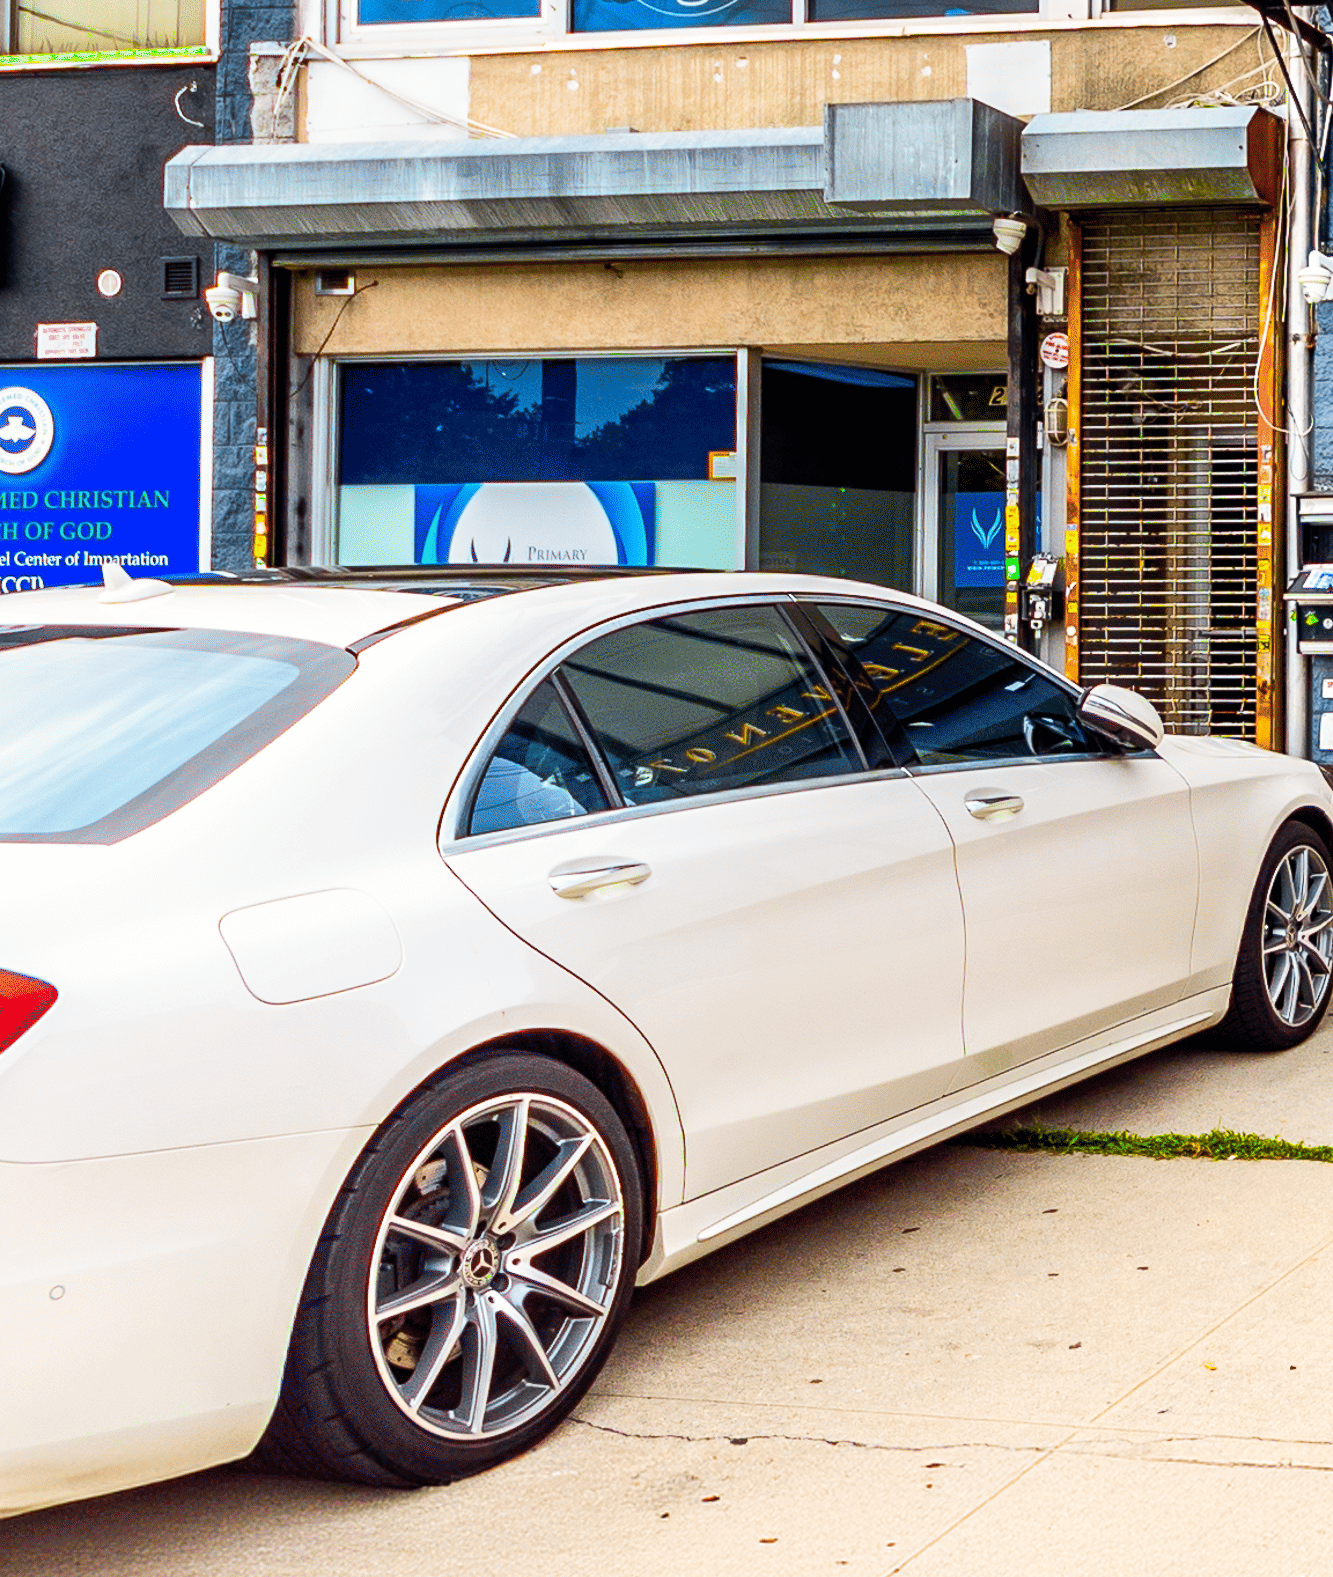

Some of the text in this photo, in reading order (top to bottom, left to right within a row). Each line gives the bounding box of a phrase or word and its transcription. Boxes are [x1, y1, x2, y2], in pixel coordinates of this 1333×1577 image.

[43, 489, 170, 510] CHRISTIAN
[24, 521, 55, 541] OF
[59, 520, 113, 541] GOD
[13, 550, 62, 567] Center
[64, 550, 81, 567] of
